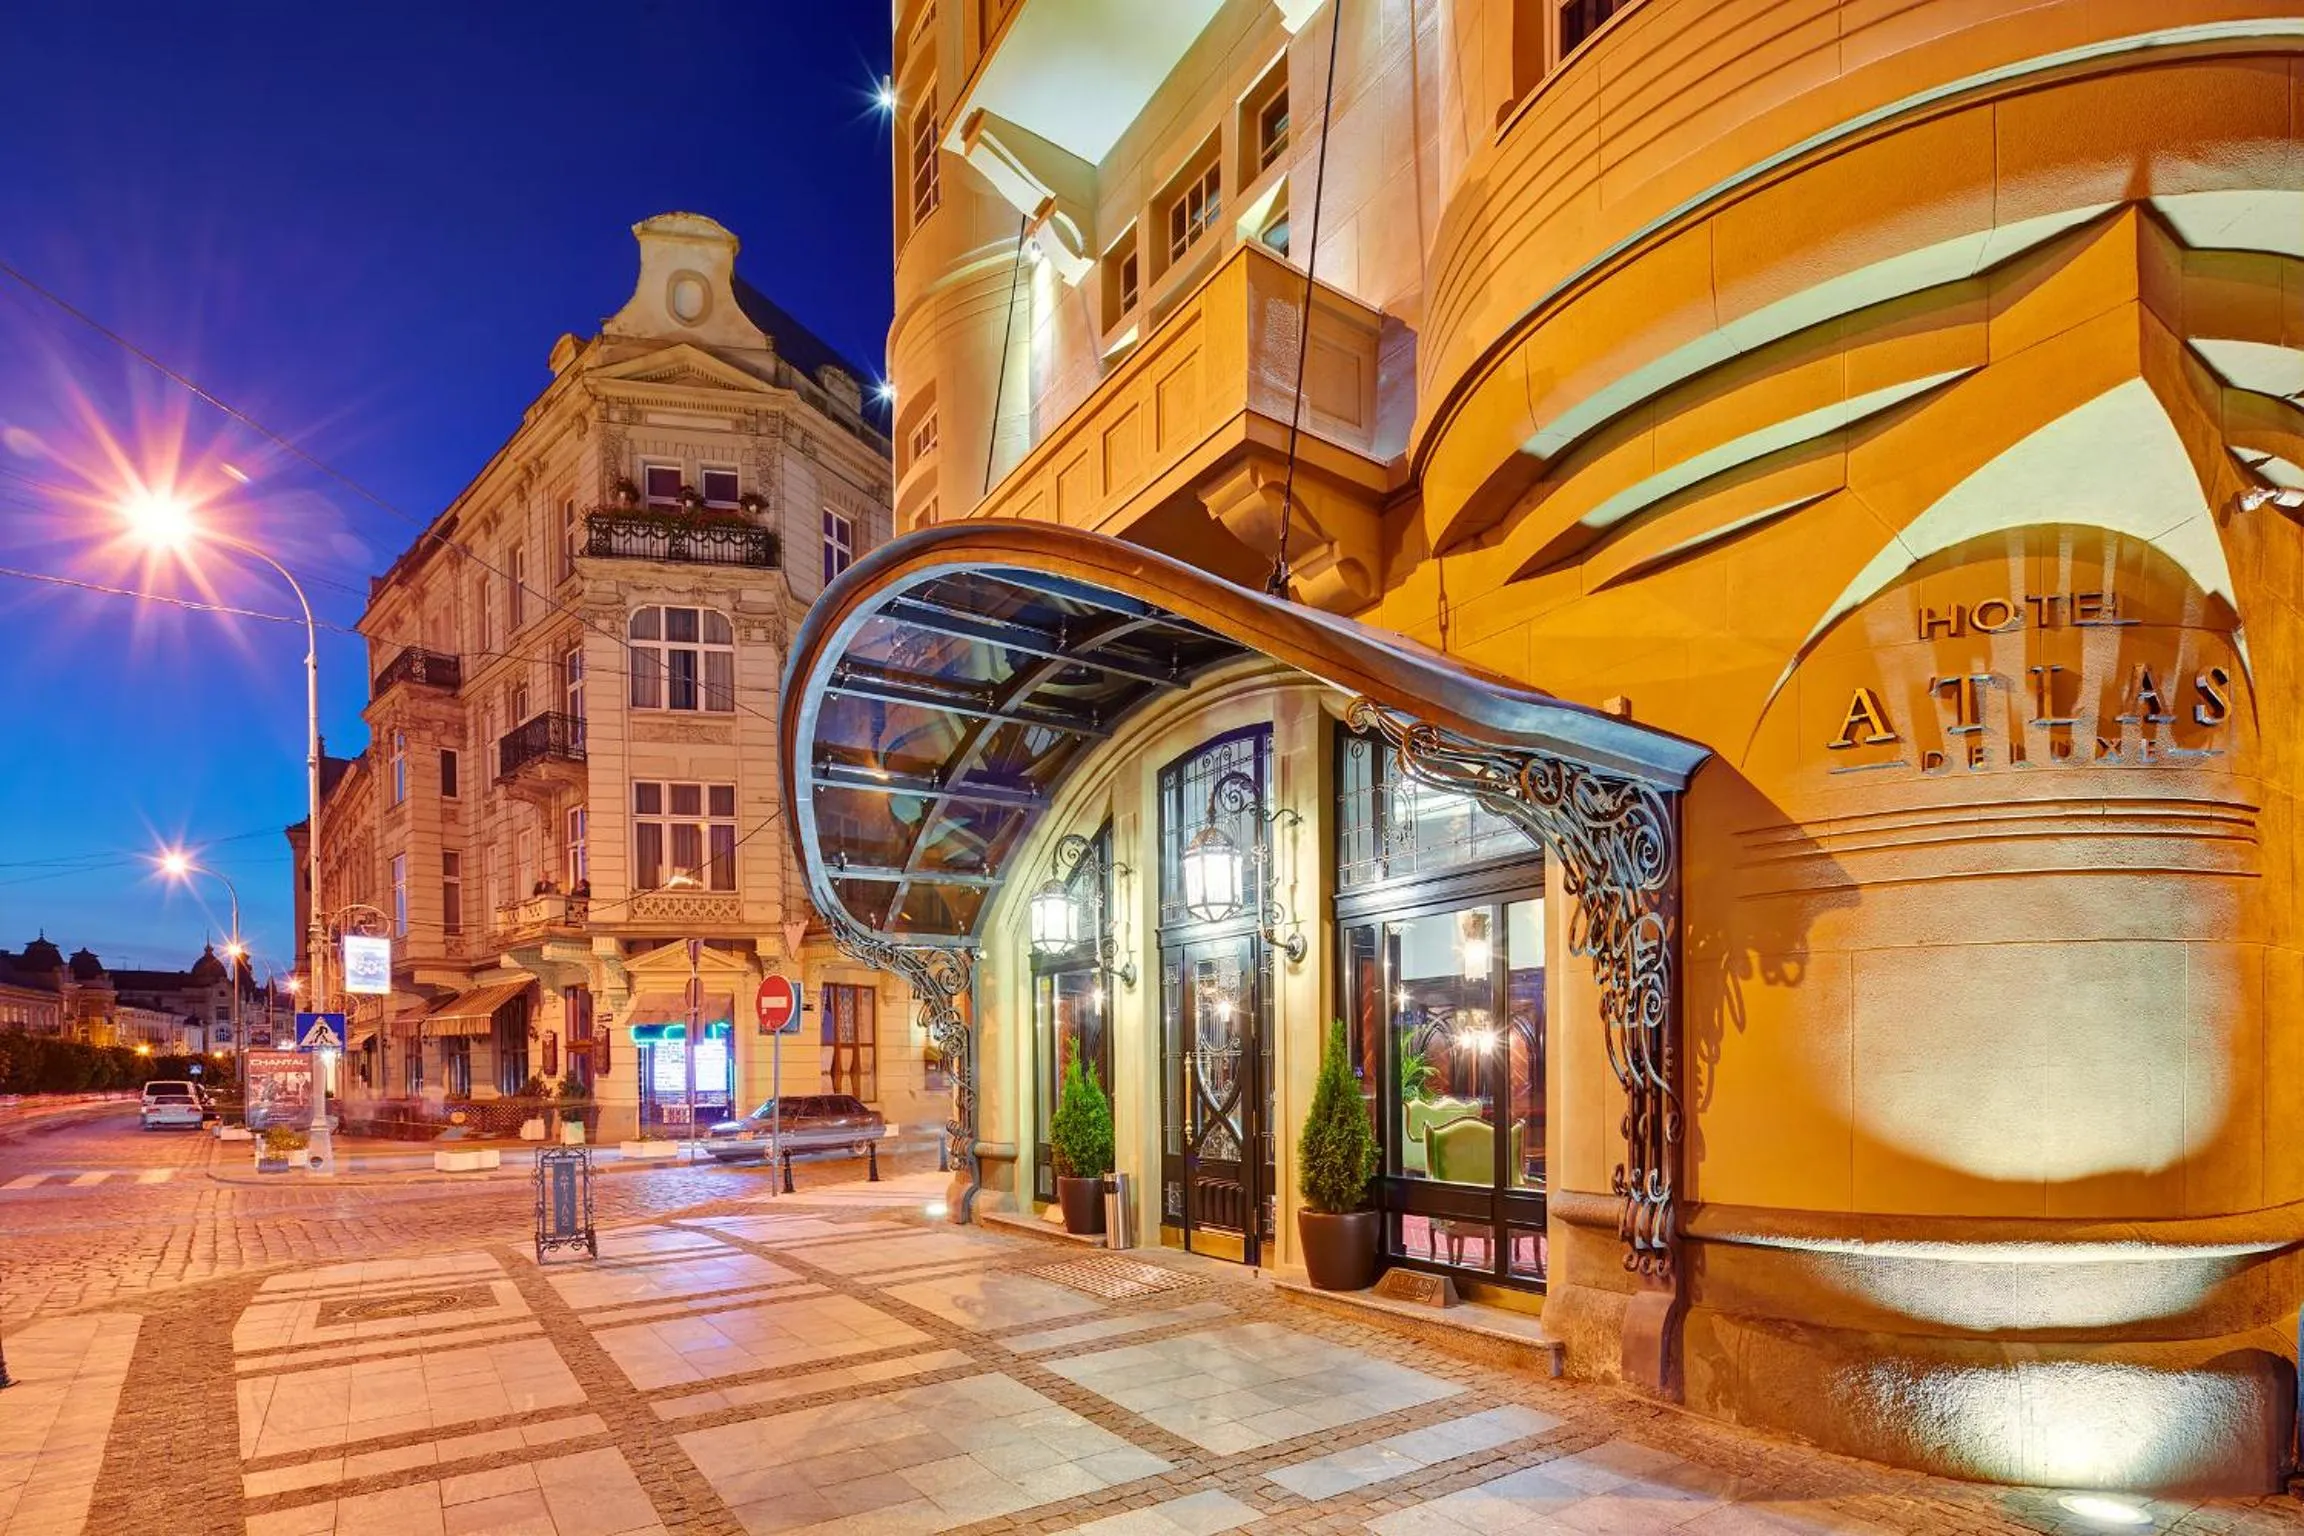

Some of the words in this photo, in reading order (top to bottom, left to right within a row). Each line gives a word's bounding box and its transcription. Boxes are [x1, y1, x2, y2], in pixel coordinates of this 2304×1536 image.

[1919, 592, 2142, 639] HOTEL
[1826, 662, 2232, 749] ATLAS
[1921, 737, 2159, 774] DELUXE
[249, 1058, 308, 1066] CHANTAL
